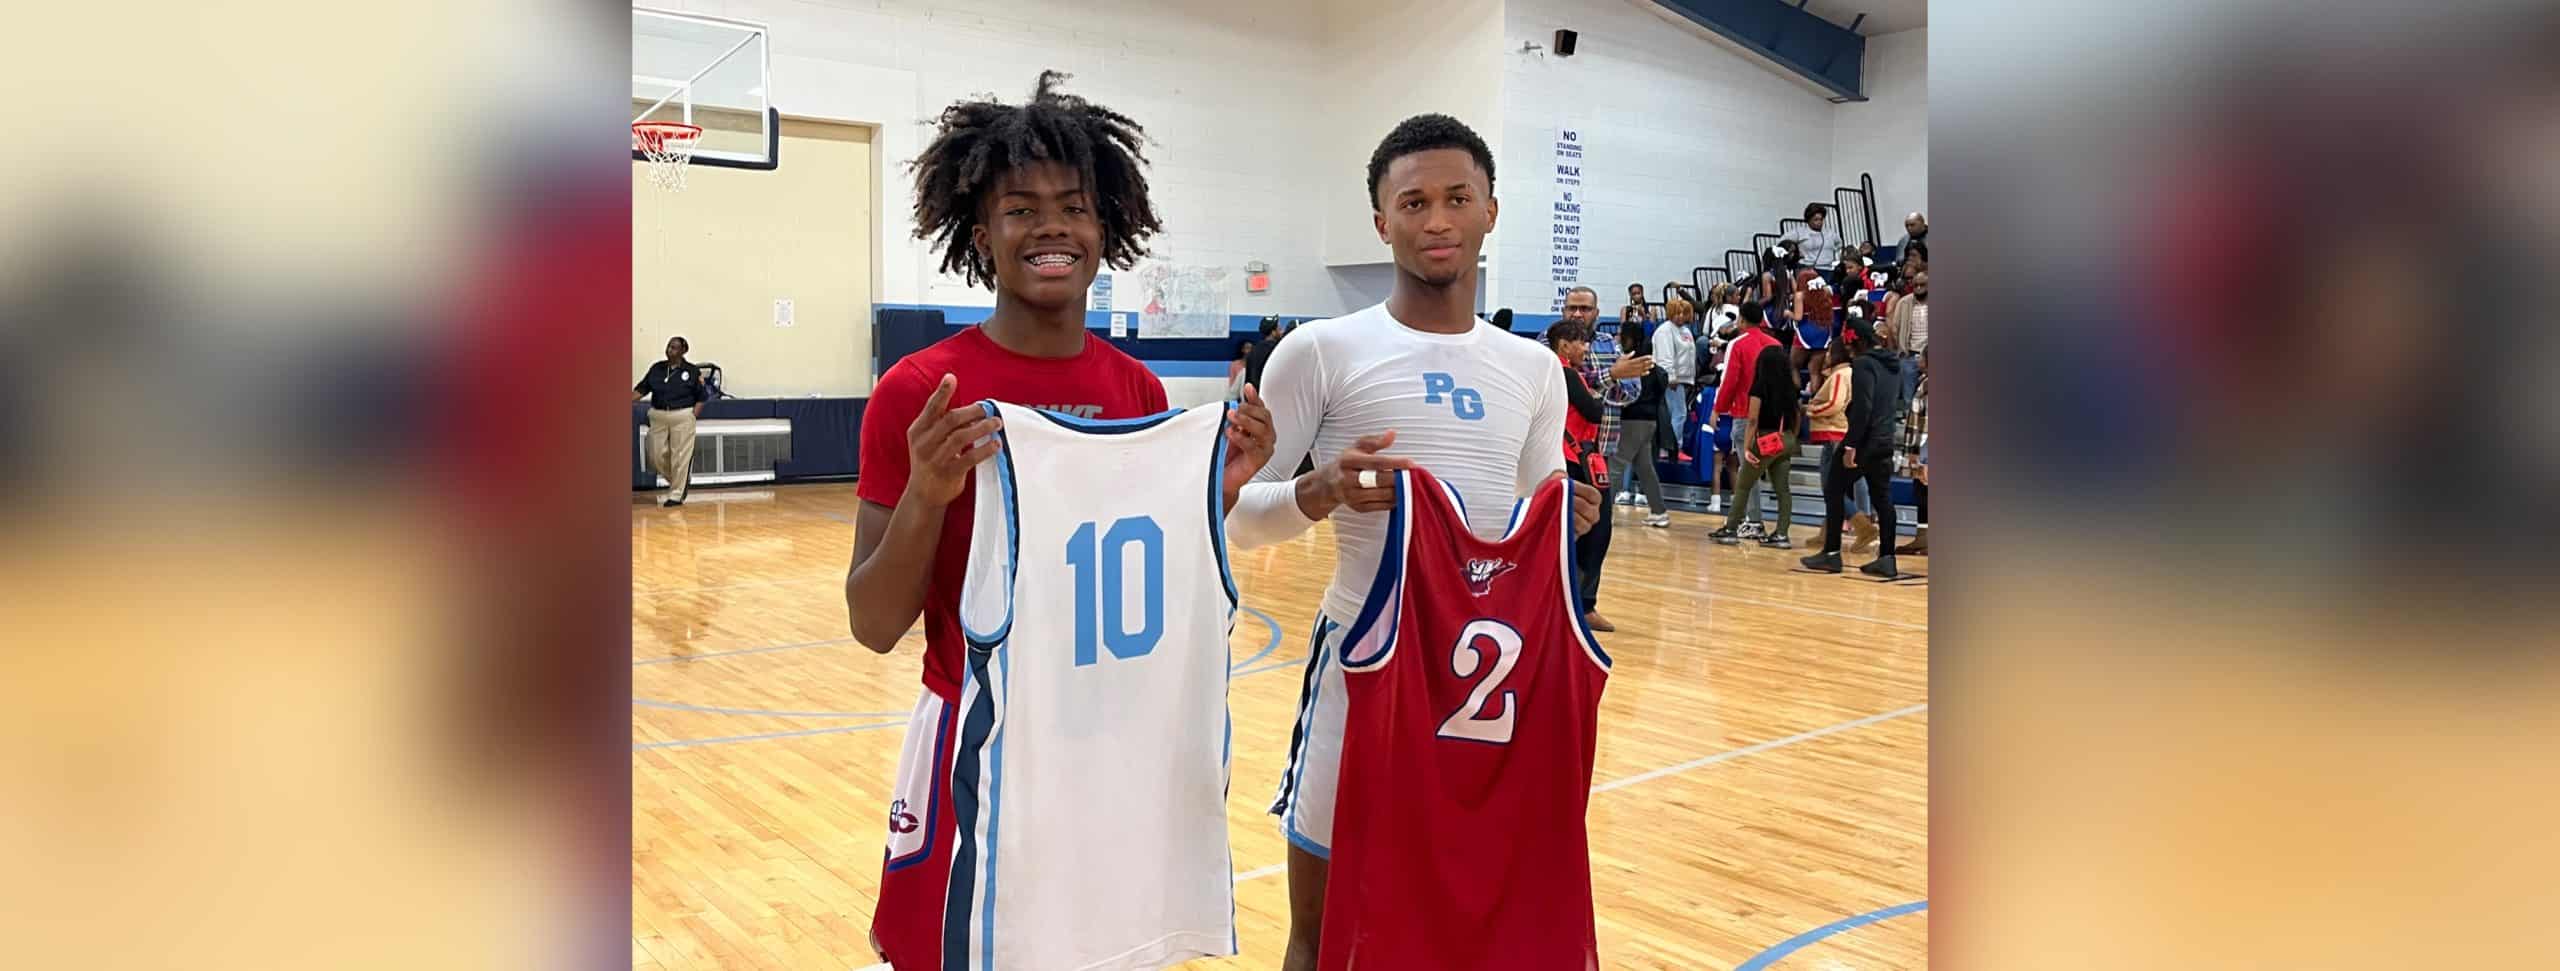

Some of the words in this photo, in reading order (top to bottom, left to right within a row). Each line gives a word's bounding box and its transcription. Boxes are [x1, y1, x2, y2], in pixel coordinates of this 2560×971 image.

[1563, 130, 1577, 141] NO
[1557, 164, 1580, 177] WALK
[1563, 192, 1572, 202] NO
[1554, 202, 1581, 214] WALKING
[1553, 224, 1564, 234] DO
[1565, 225, 1580, 235] NOT
[1552, 255, 1563, 265] DO
[1564, 256, 1579, 266] NOT
[1422, 372, 1486, 420] PG
[1066, 515, 1164, 667] 10
[1436, 617, 1525, 745] 2
